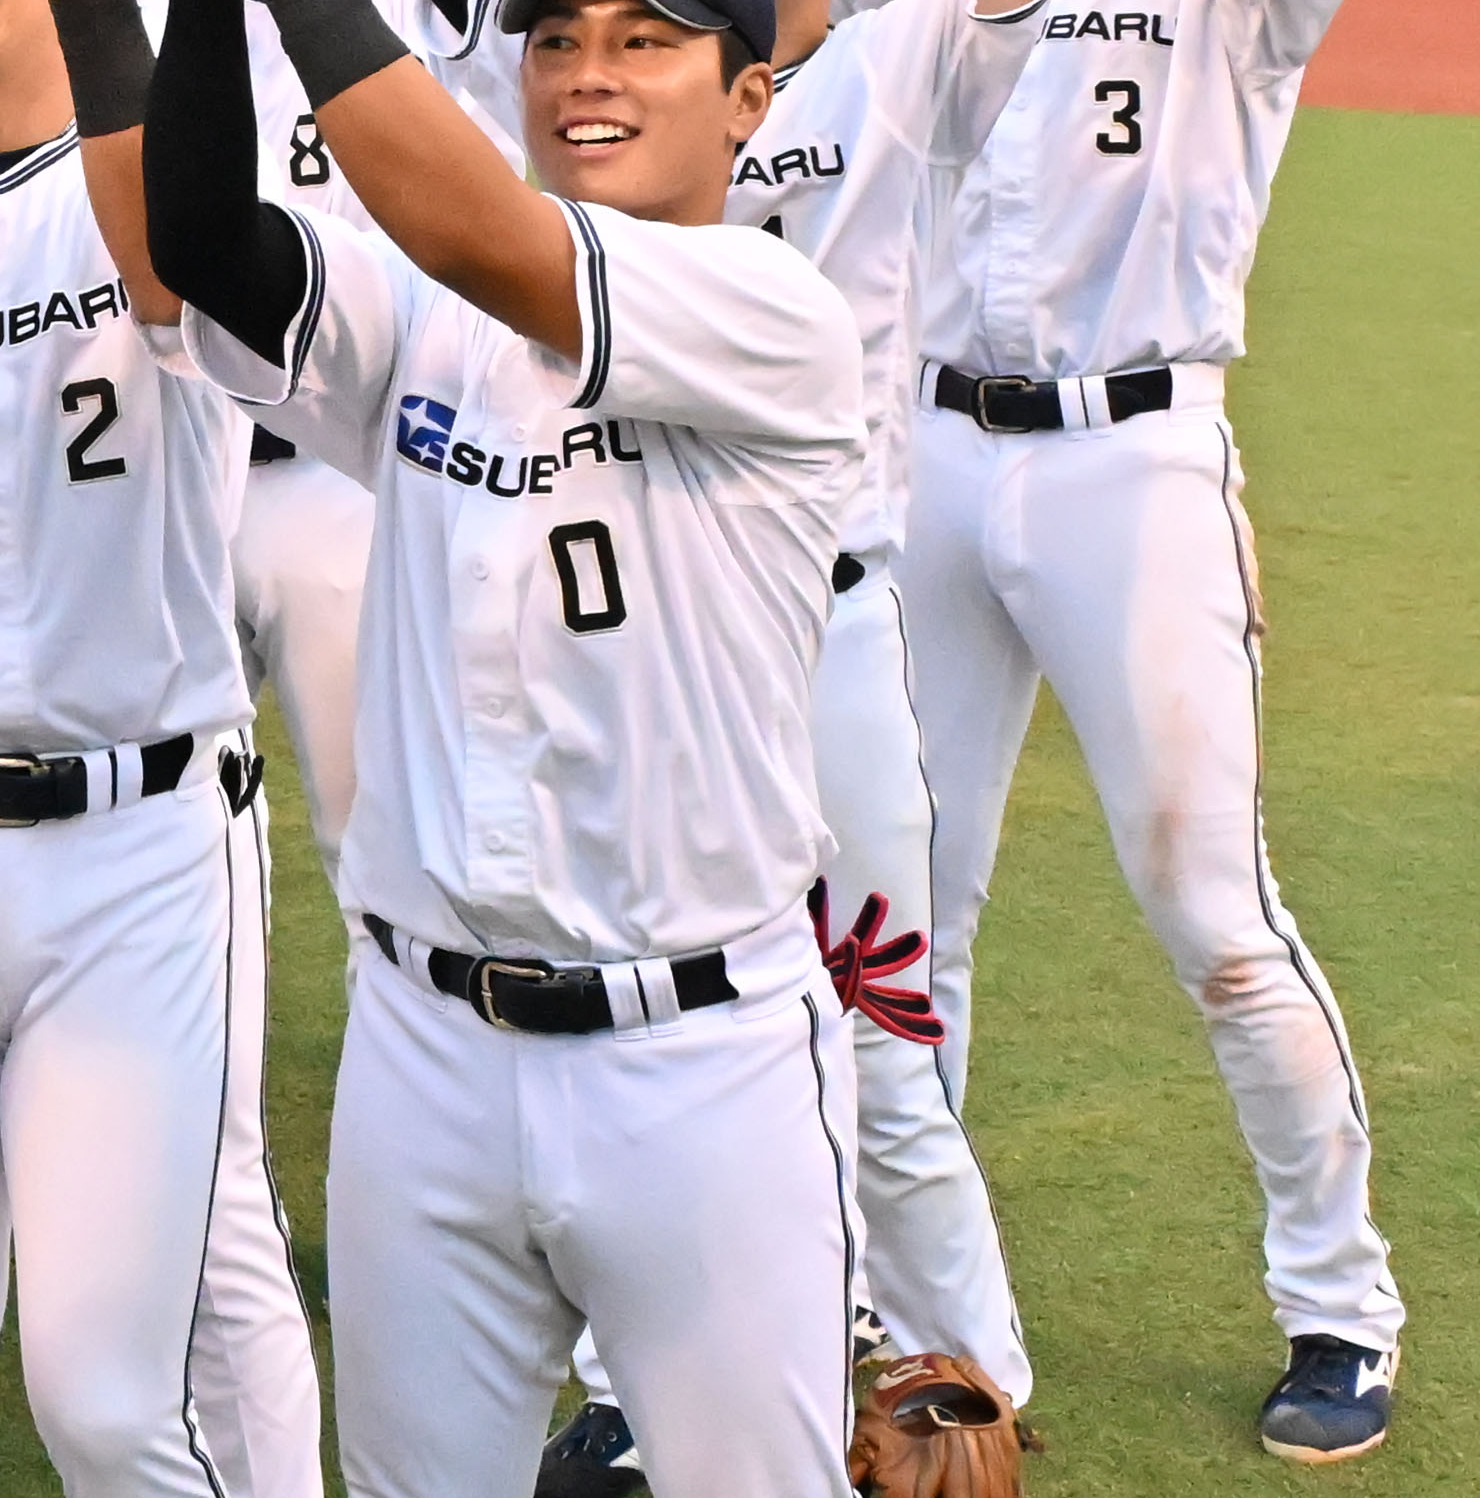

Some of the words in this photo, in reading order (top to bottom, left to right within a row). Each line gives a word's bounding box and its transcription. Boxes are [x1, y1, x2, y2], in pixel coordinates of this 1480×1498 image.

[1038, 11, 1175, 46] BARU
[289, 114, 330, 186] 8
[1094, 79, 1143, 155] 3
[60, 377, 127, 483] 2
[548, 518, 628, 634] 0
